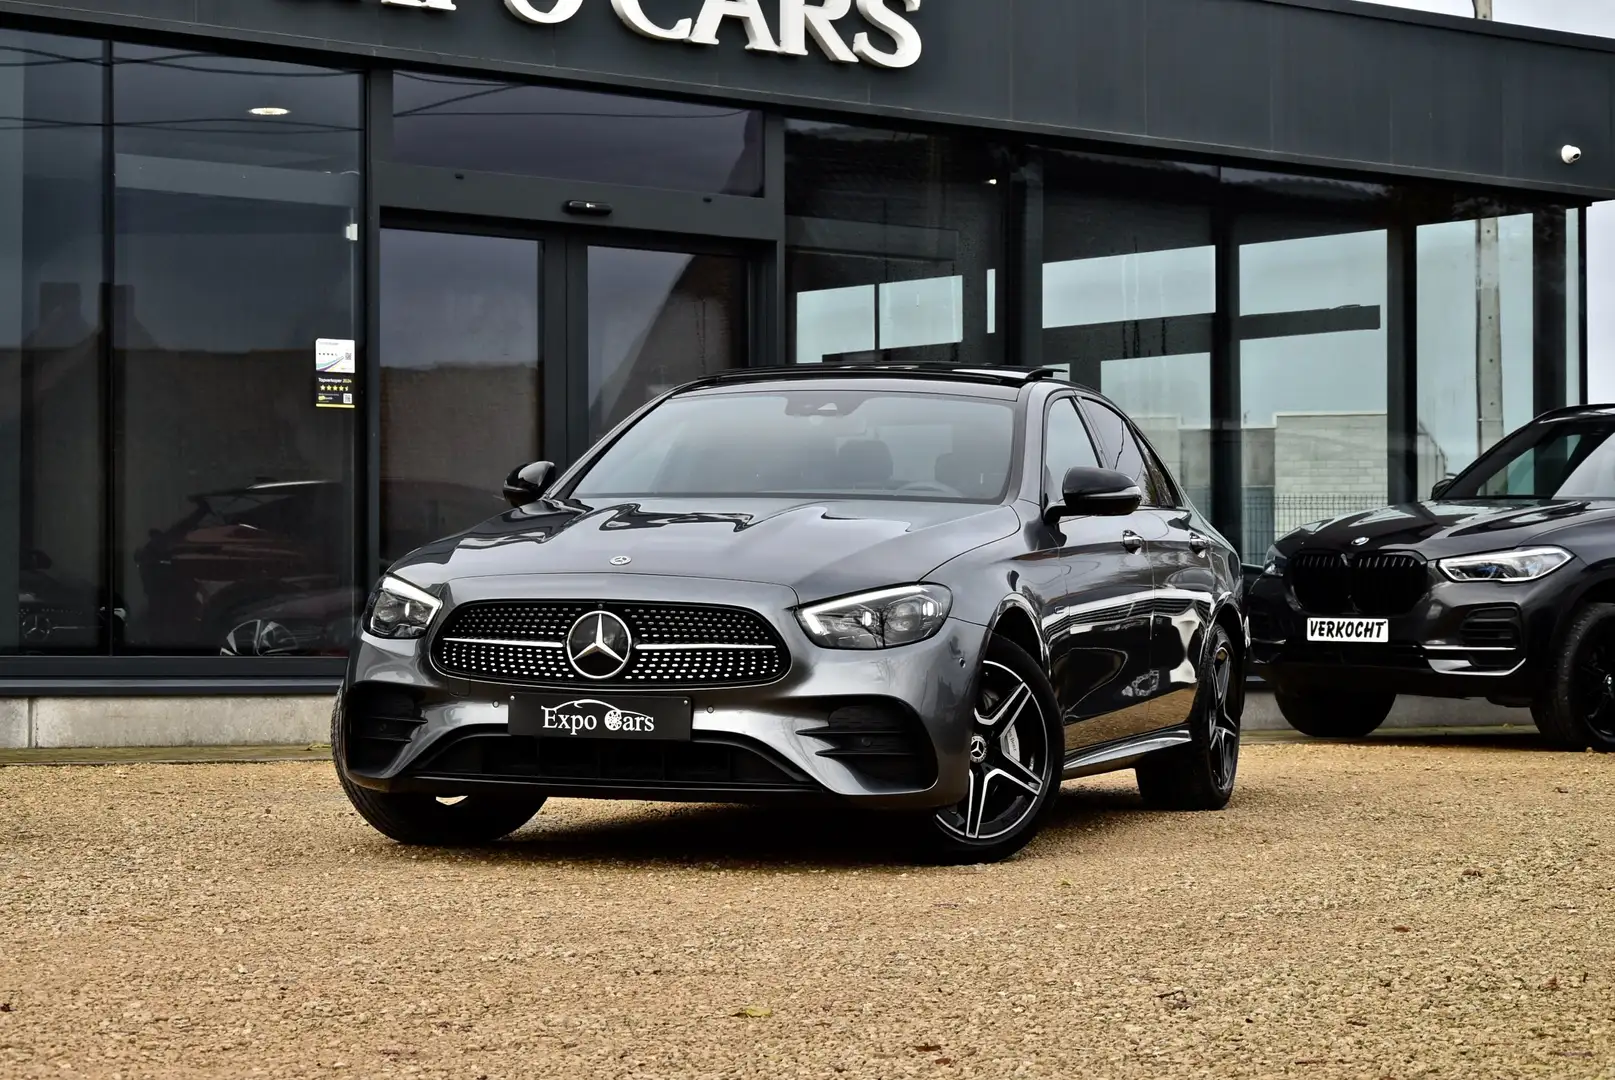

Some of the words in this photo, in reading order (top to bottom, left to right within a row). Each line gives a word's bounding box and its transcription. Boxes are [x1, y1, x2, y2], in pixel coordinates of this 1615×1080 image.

[1310, 620, 1387, 638] VERKOCHT
[541, 705, 597, 735] Expo
[604, 709, 655, 732] Cars
